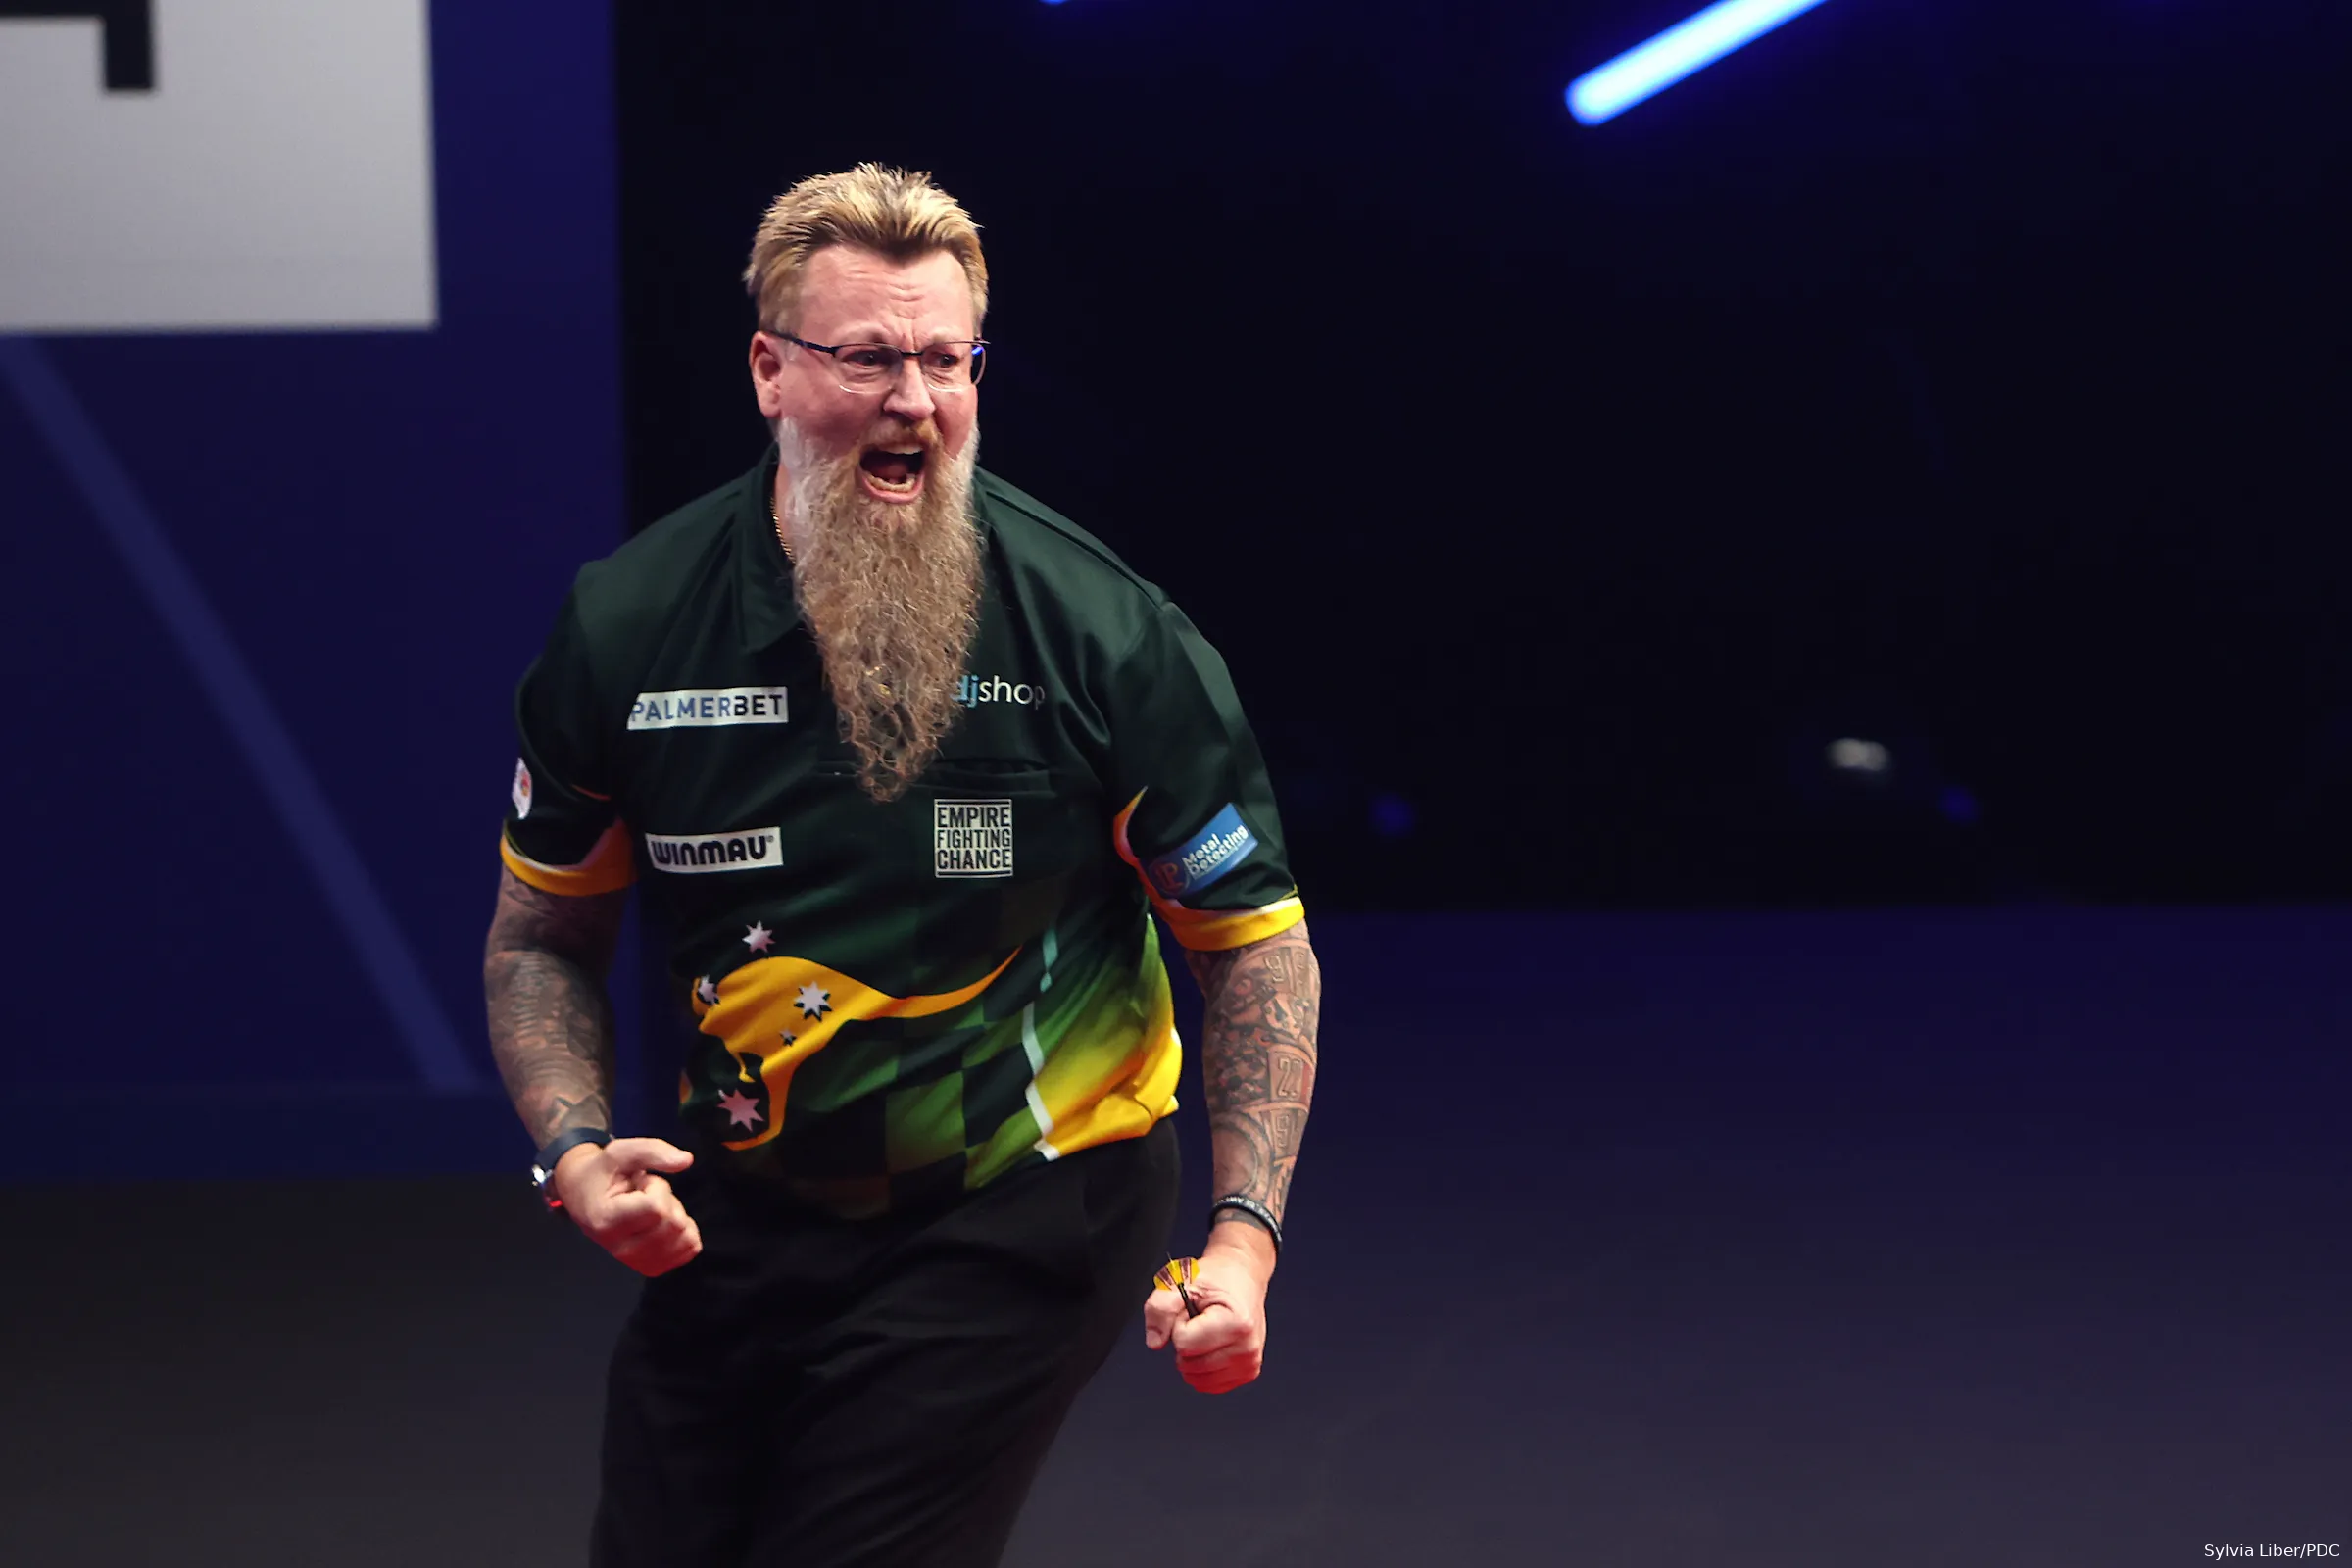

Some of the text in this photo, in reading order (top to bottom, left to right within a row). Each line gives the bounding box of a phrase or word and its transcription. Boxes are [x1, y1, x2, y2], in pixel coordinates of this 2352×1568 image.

[631, 694, 783, 722] PALMERBET
[937, 807, 1011, 828] EMPIRE
[937, 829, 1011, 849] FIGHTING
[1181, 833, 1221, 864] Metal
[1185, 824, 1250, 877] Detecting
[937, 849, 1012, 870] CHANCE
